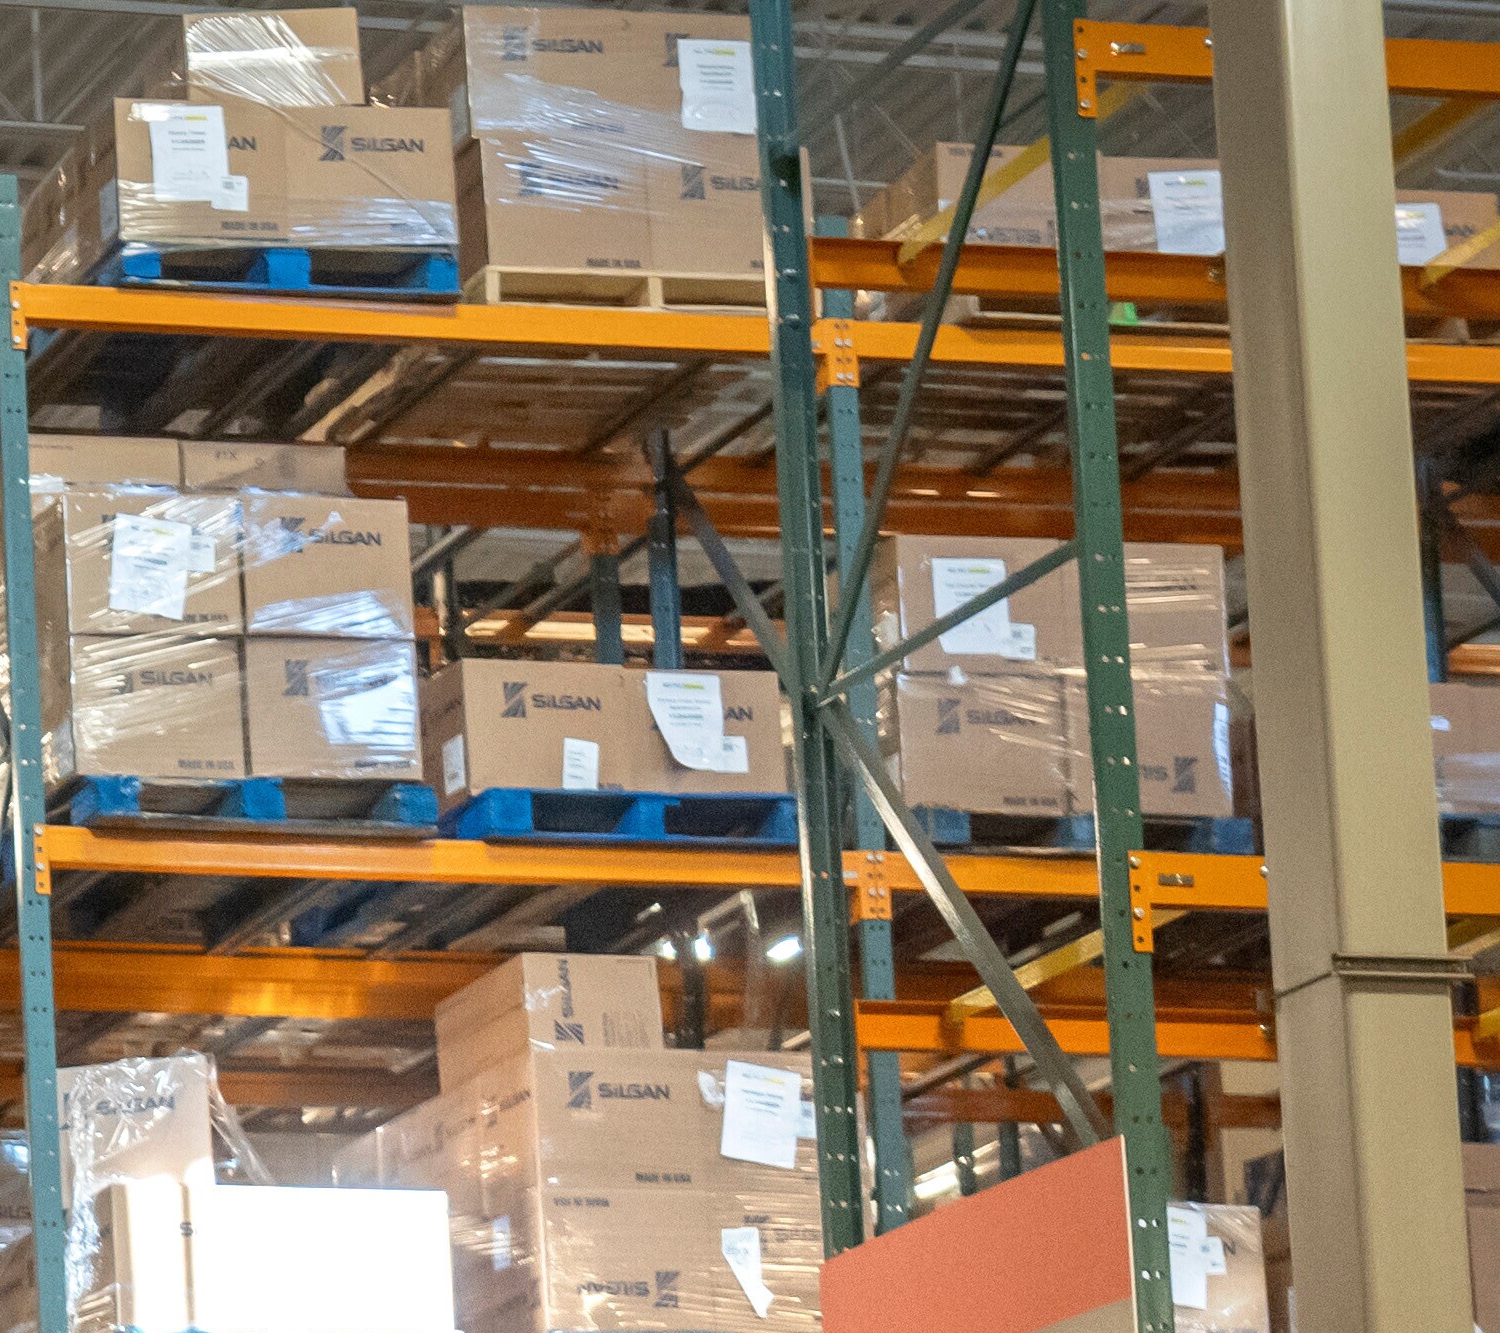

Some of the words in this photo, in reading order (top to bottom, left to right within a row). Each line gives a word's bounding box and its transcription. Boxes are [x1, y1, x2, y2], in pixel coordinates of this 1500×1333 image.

[350, 137, 425, 154] SILGAN
[308, 527, 382, 547] SILGAN
[140, 670, 213, 687] SILGAN
[531, 693, 601, 712] SILGAN
[561, 958, 574, 1017] SILGAN
[597, 1083, 671, 1100] SILGAN
